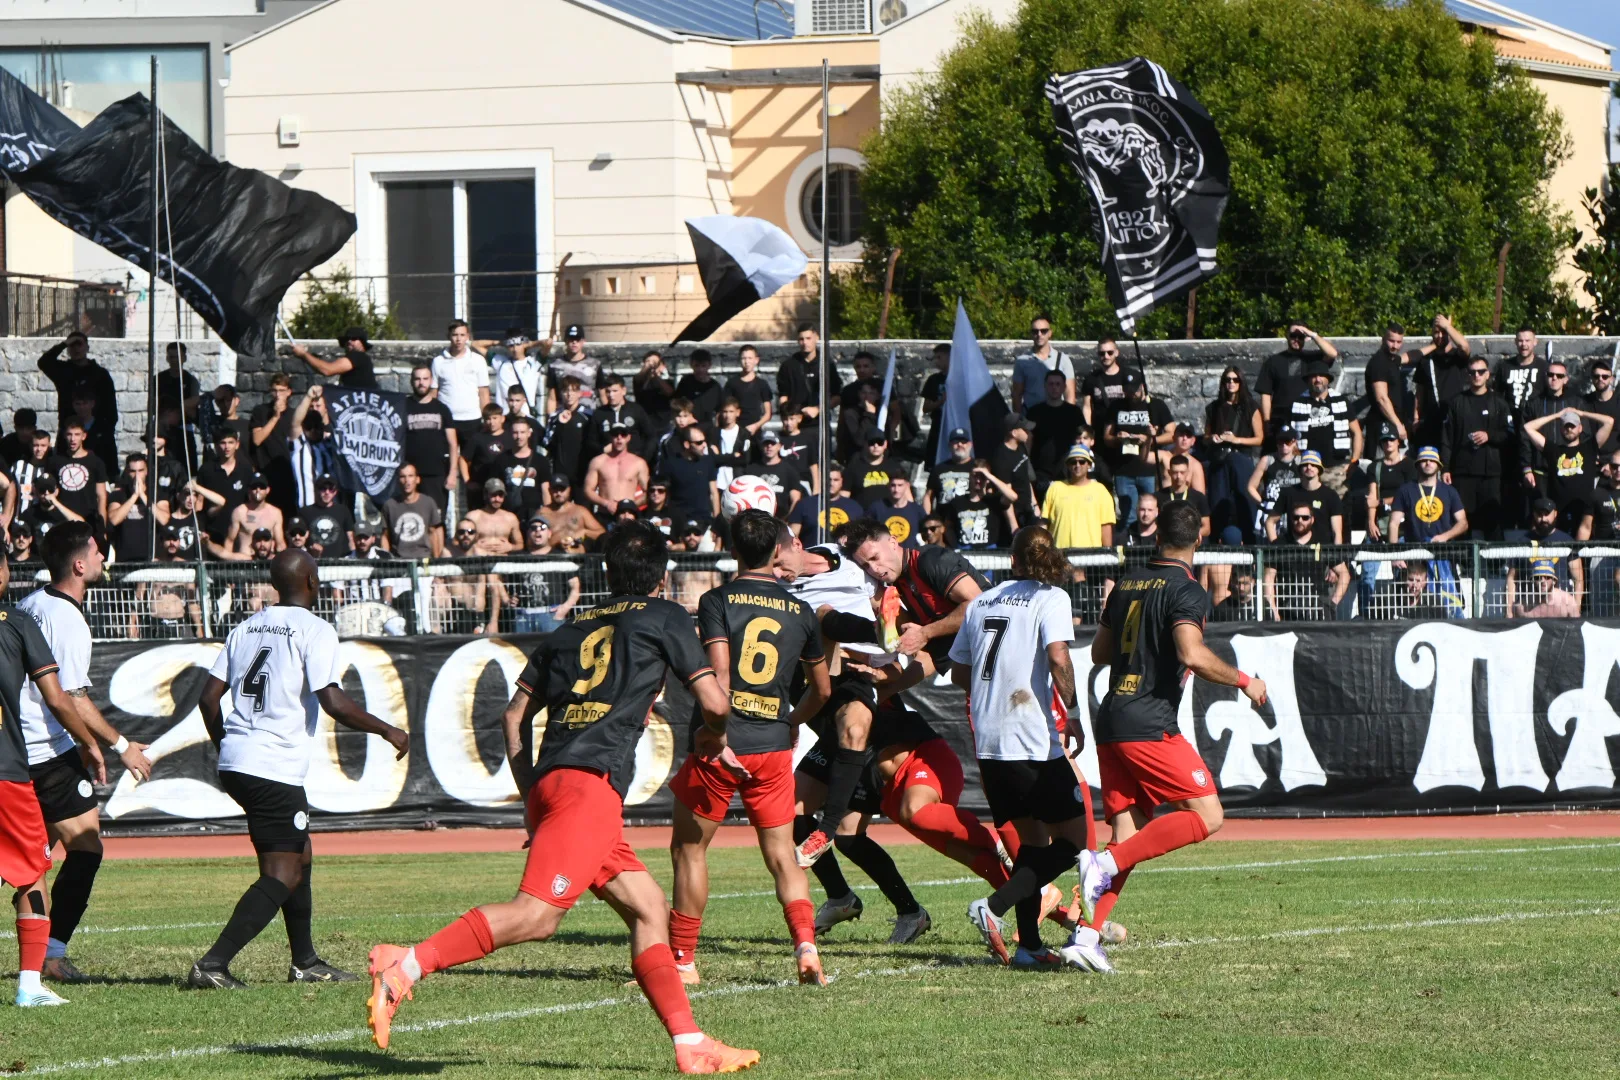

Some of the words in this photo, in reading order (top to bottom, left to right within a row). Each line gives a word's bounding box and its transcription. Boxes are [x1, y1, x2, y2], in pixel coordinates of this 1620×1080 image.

[1107, 204, 1156, 228] 1927
[332, 391, 402, 428] ATHENS
[629, 602, 647, 611] FC
[728, 594, 785, 611] PANACHAIKI
[788, 601, 800, 614] FC
[571, 625, 614, 694] 9
[738, 616, 781, 685] 6
[982, 616, 1010, 680] 7
[241, 646, 272, 712] 4
[733, 695, 777, 712] Carhino
